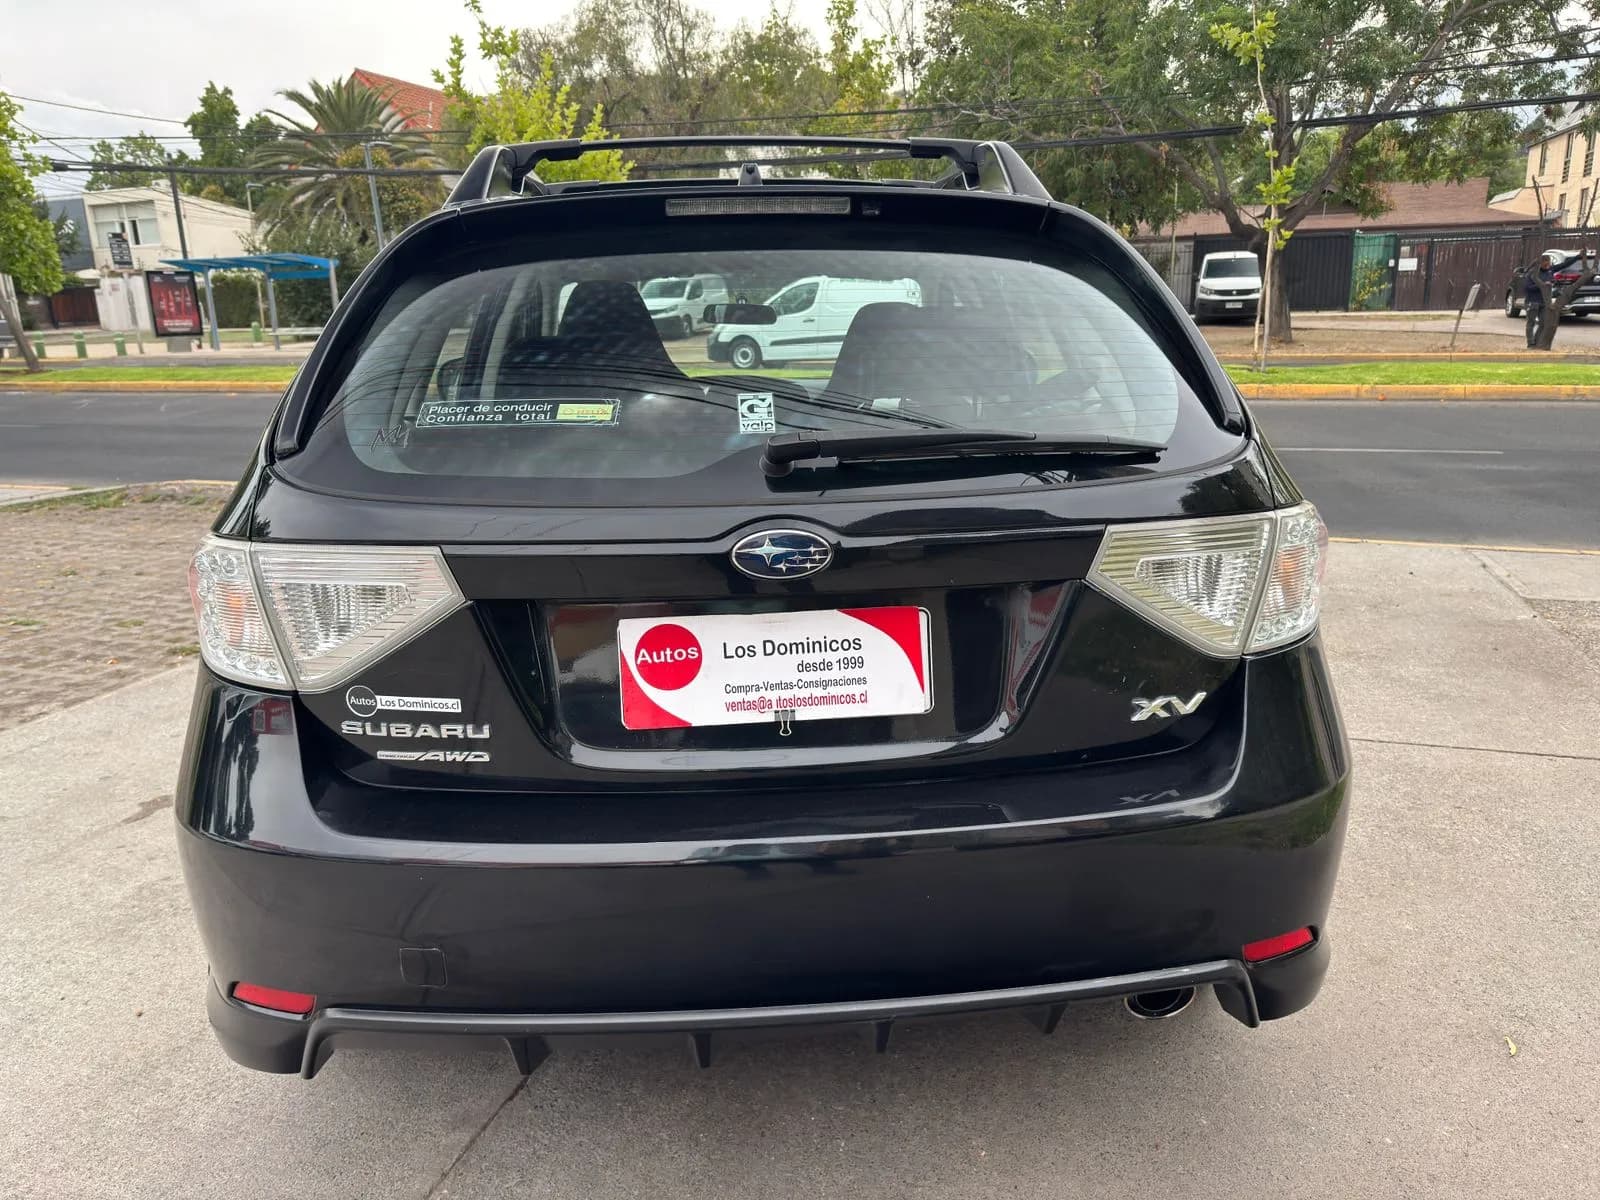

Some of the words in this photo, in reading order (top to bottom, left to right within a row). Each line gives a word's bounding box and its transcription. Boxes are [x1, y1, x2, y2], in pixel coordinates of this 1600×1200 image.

[429, 405, 470, 414] Placer
[473, 404, 490, 412] de
[494, 402, 553, 412] conducir
[426, 413, 503, 423] Confianza
[515, 412, 551, 421] total
[742, 421, 774, 432] valp
[636, 646, 699, 665] Autos
[723, 641, 757, 659] Los
[762, 636, 862, 657] Dominicos
[796, 658, 833, 673] desde
[835, 655, 864, 671] 1999
[724, 675, 868, 695] Compra-Ventas-Consignaciones
[350, 696, 376, 706] Autos
[379, 698, 396, 707] Los
[399, 699, 460, 711] Dominicos.cl
[1130, 692, 1207, 722] XV
[341, 720, 490, 739] SUBARU
[415, 751, 491, 762] AWD
